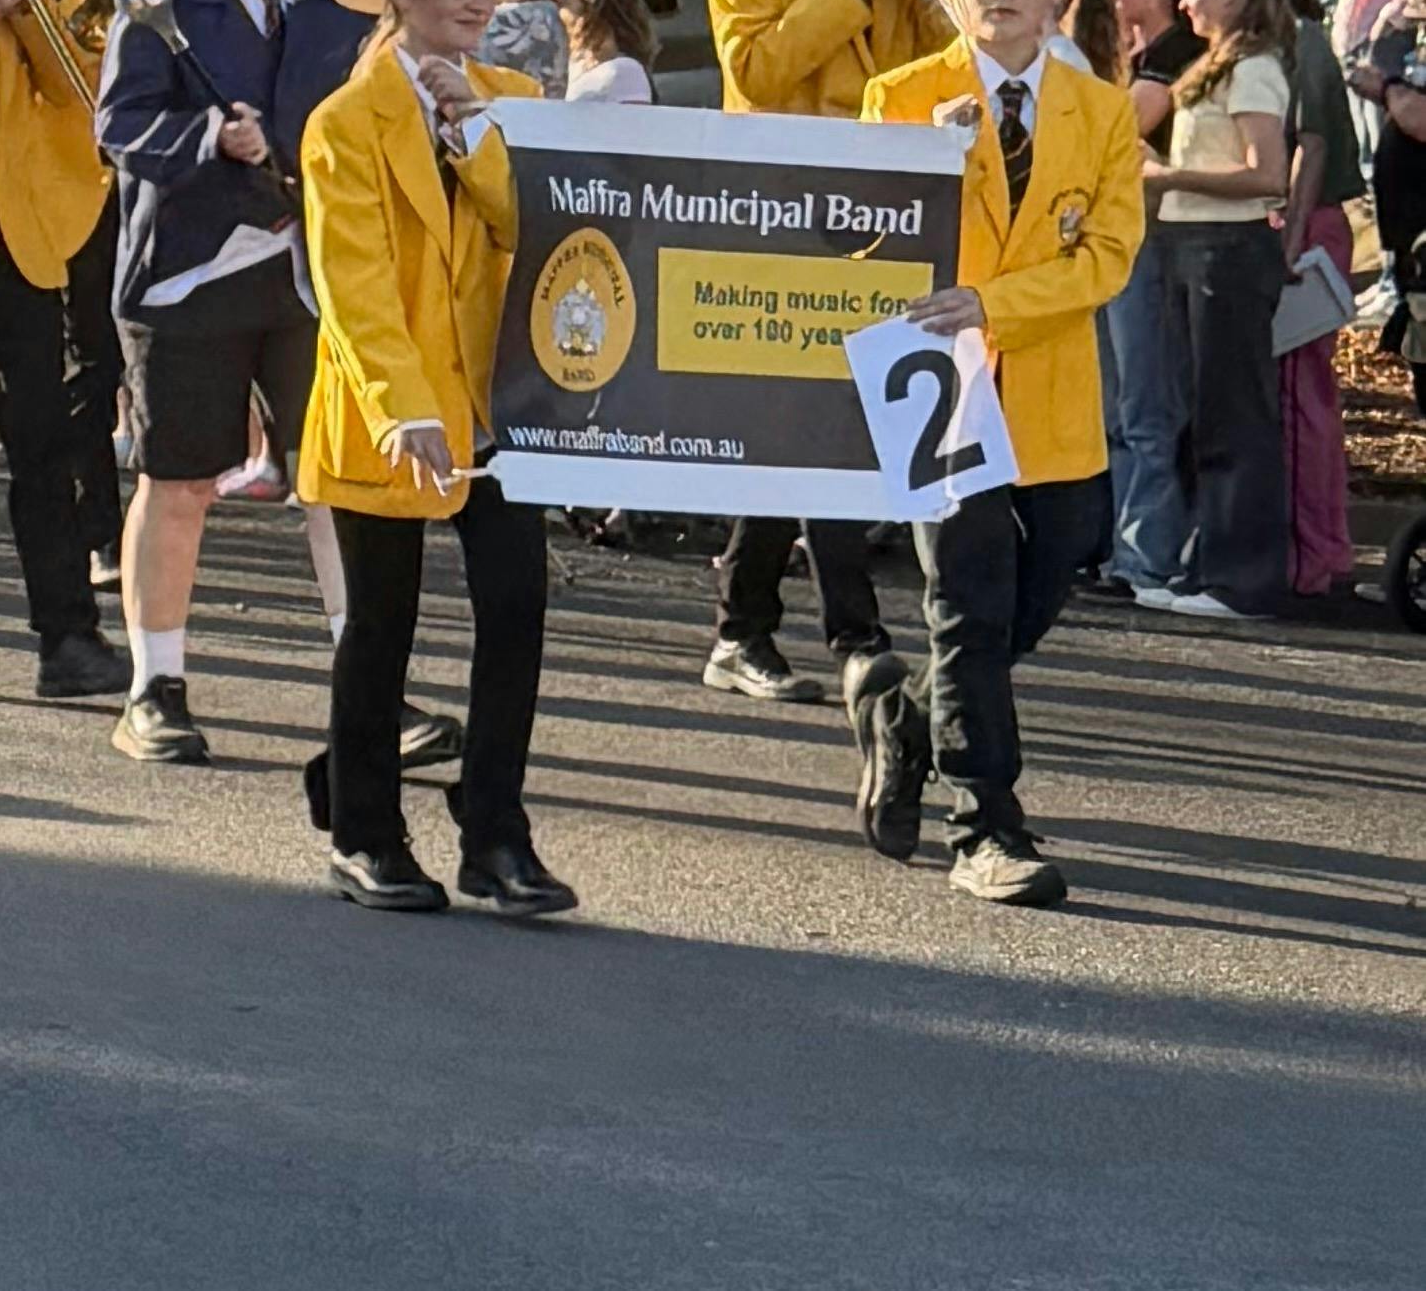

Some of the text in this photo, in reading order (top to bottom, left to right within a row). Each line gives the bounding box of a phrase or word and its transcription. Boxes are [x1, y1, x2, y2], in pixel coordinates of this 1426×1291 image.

[549, 176, 924, 235] Maffra Municipal Band
[694, 281, 910, 315] Making music for
[693, 320, 746, 340] over
[801, 328, 855, 351] yea
[885, 349, 987, 491] 2
[507, 425, 745, 459] www.maffraband.com.au
